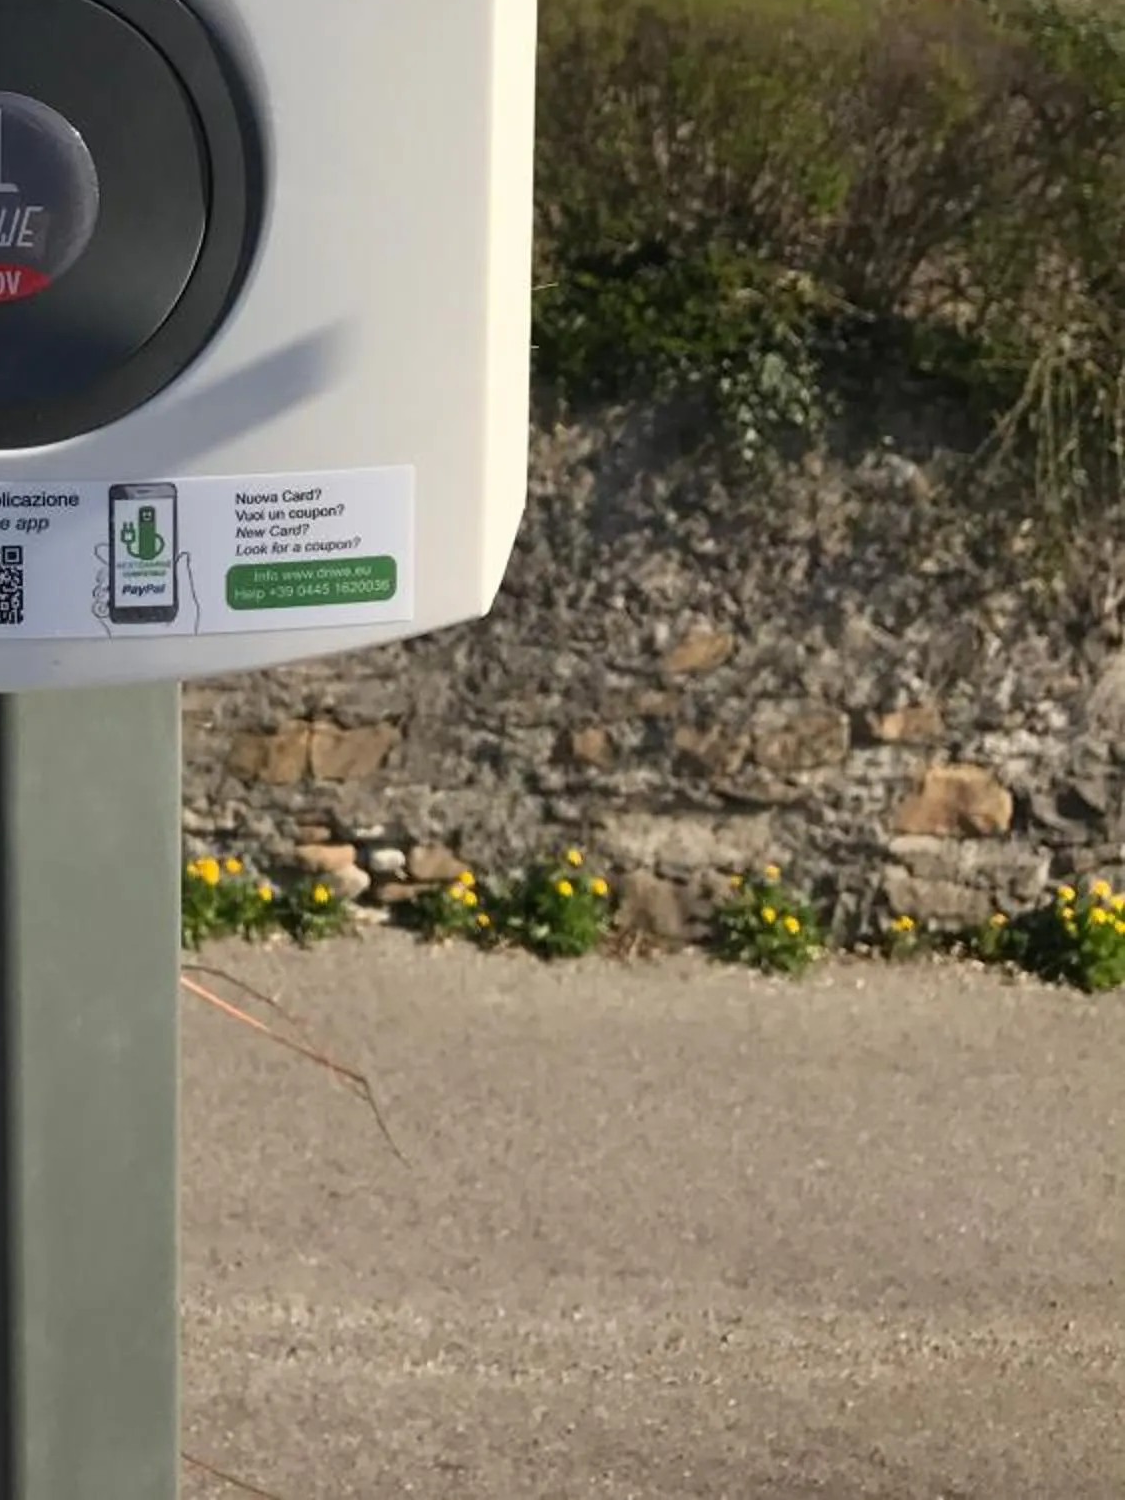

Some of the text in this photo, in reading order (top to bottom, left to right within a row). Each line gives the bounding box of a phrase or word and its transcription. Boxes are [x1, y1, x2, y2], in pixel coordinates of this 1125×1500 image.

[235, 488, 323, 505] Nuova Card?
[235, 503, 346, 521] Vuoi un coupon?
[15, 517, 50, 534] app
[235, 524, 311, 538] New Card?
[235, 536, 362, 556] Look for a coupon?
[121, 583, 166, 597] PayPal
